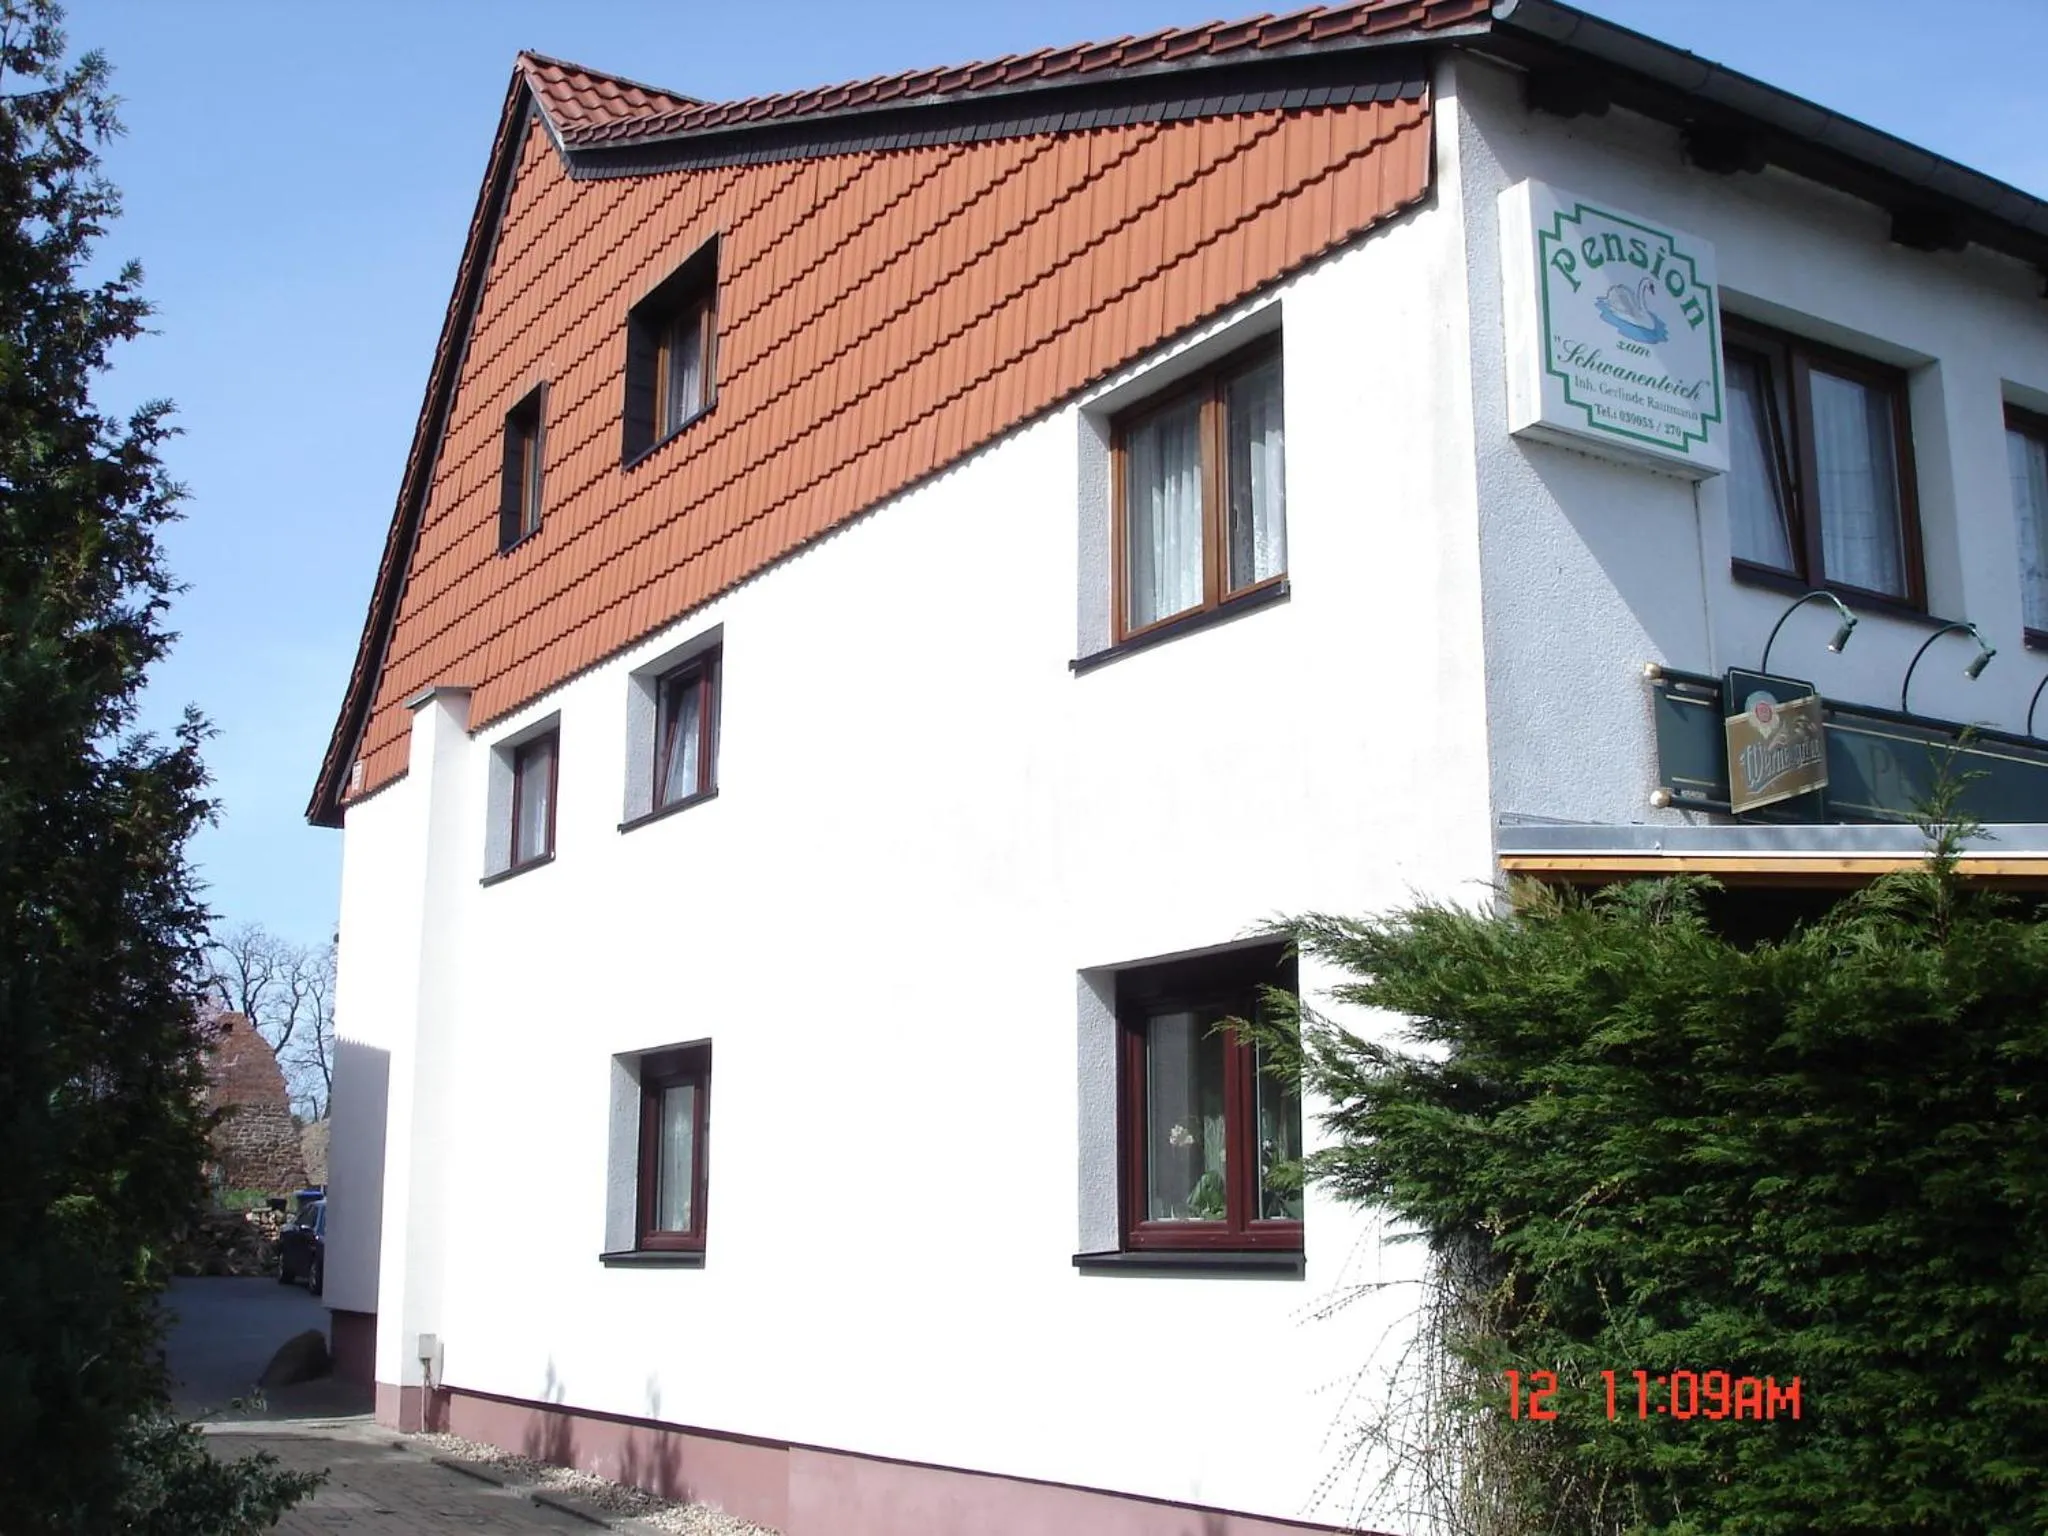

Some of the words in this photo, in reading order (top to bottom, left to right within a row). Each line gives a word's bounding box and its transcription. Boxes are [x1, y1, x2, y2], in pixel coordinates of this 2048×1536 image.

[1616, 340, 1652, 359] zum
[1574, 375, 1597, 392] Inh.
[1600, 382, 1645, 406] Gerlinde
